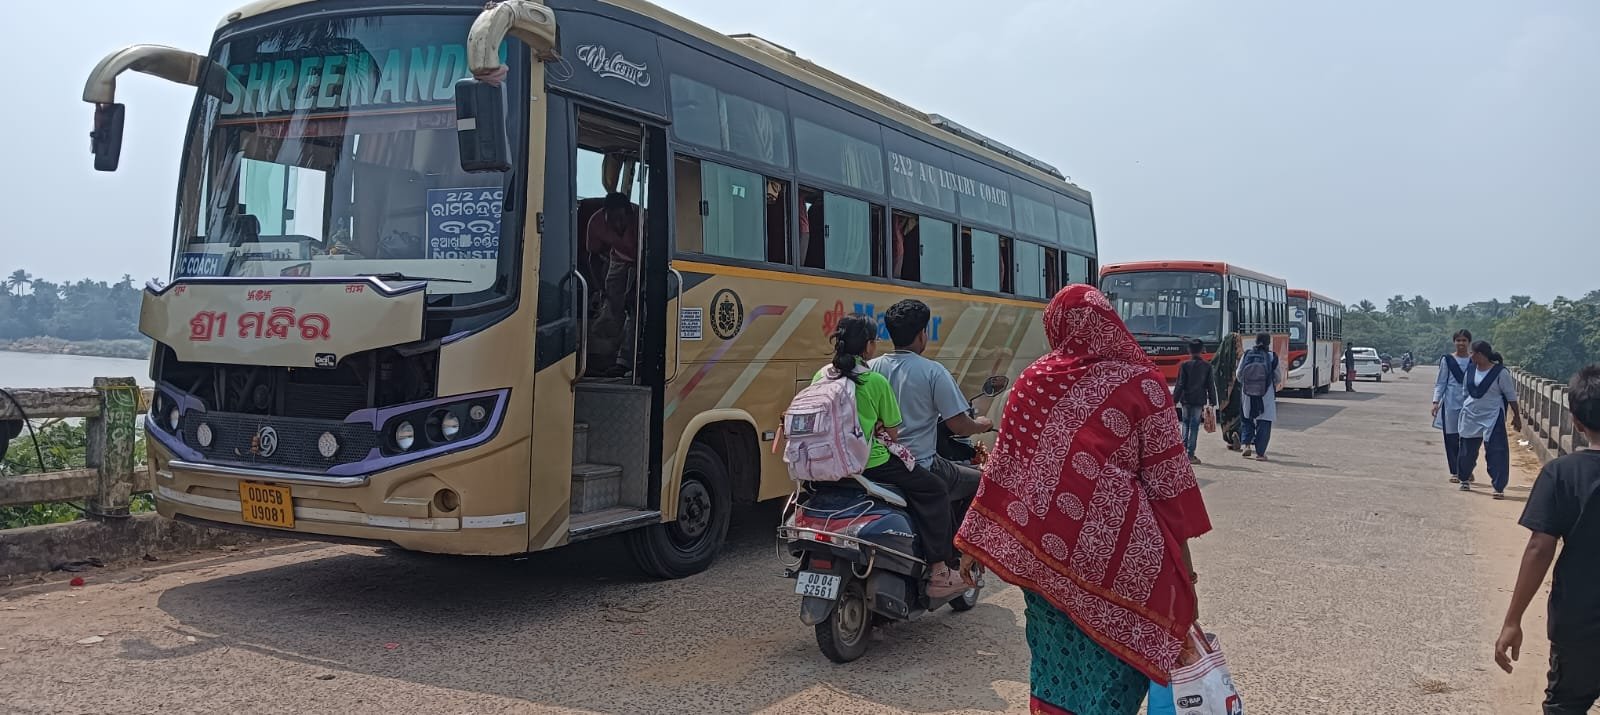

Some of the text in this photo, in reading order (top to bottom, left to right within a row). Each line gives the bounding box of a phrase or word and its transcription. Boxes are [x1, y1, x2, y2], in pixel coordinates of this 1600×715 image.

[576, 45, 650, 87] Welcome
[220, 40, 508, 116] SHREEMAND
[446, 192, 473, 201] 2/2
[939, 168, 976, 197] LUXURY
[980, 182, 1008, 207] COACH
[431, 202, 502, 218] ରାମଚନ୍ଦ୍ରପୁ
[439, 220, 501, 234] ବର
[187, 256, 218, 275] COACH
[237, 306, 331, 341] ମନ୍ଦିର
[251, 505, 285, 523] U9081
[821, 575, 833, 587] 04
[803, 584, 832, 598] S2561
